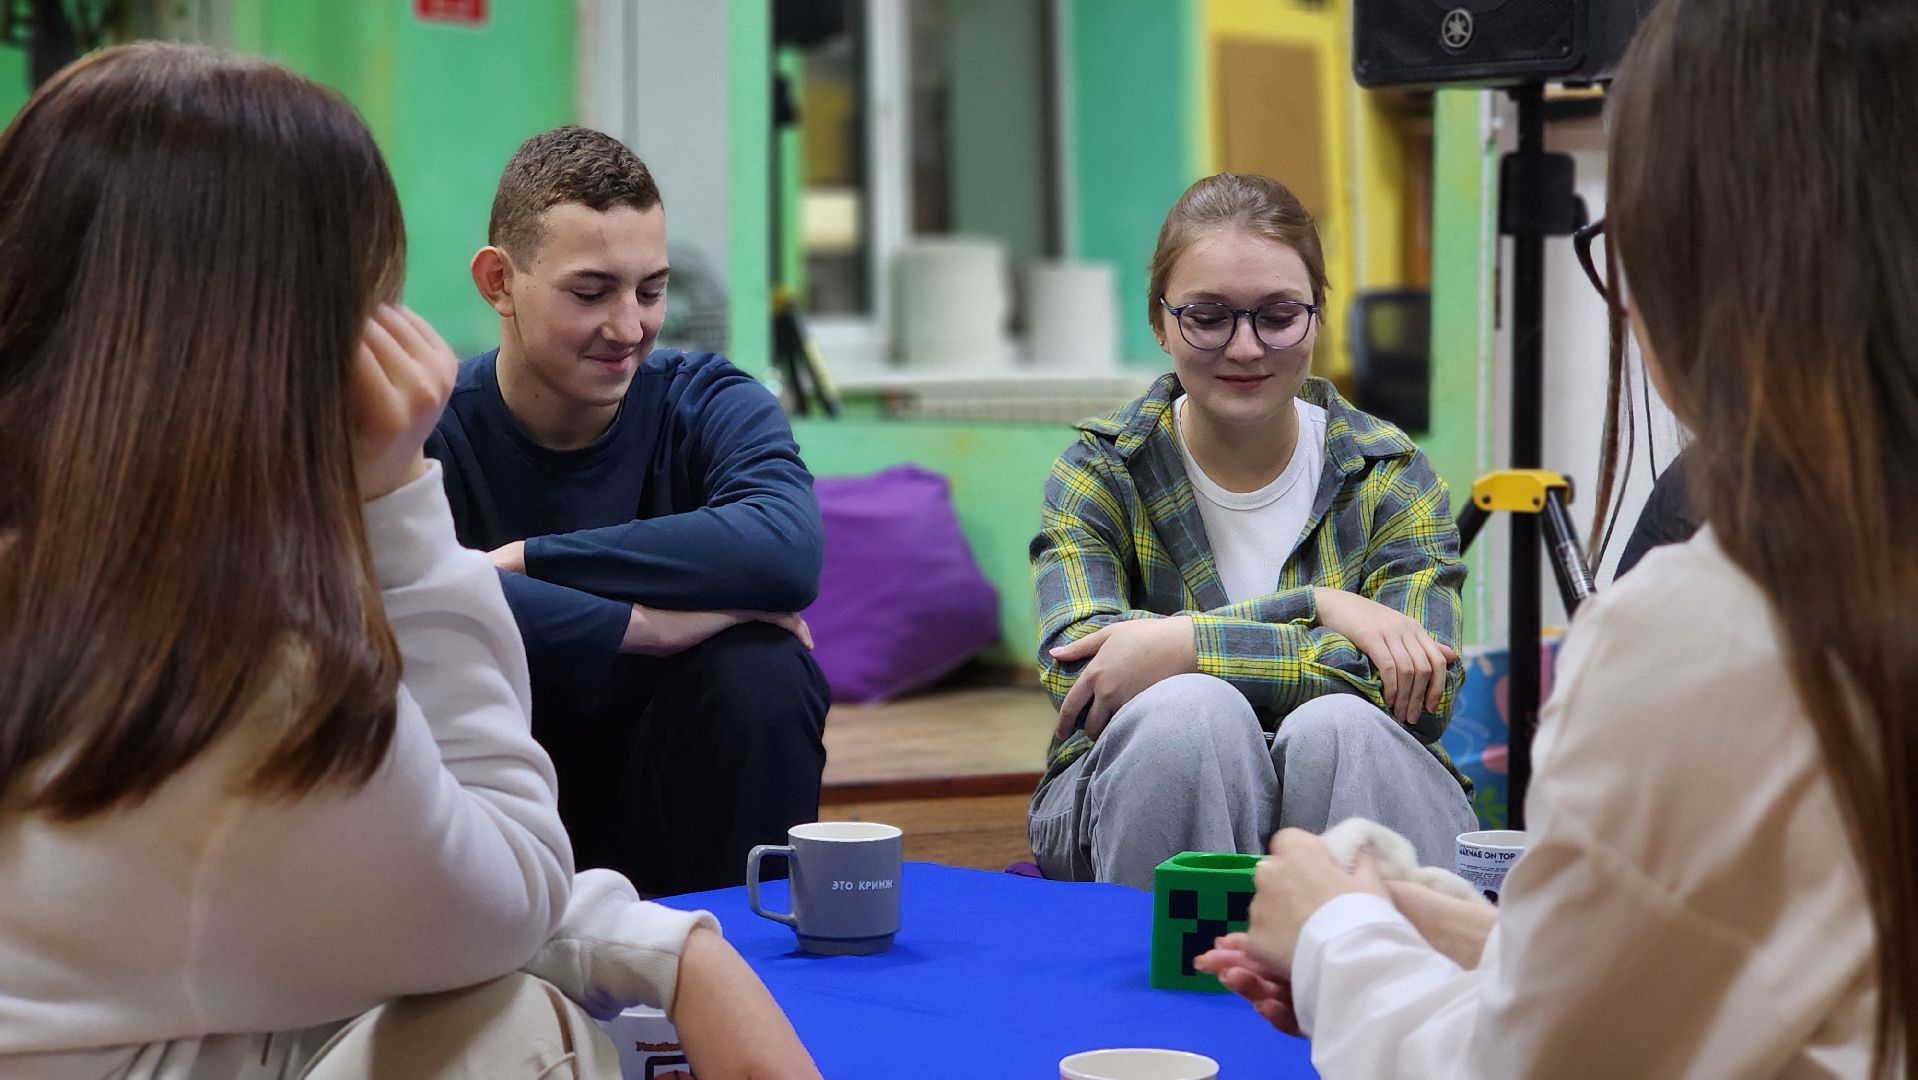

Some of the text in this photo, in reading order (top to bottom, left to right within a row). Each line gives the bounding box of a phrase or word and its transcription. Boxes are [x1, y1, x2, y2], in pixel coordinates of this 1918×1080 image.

[1484, 851, 1497, 860] ON
[1498, 852, 1516, 860] TOP
[831, 879, 894, 891] ЭТО КРИНЖ
